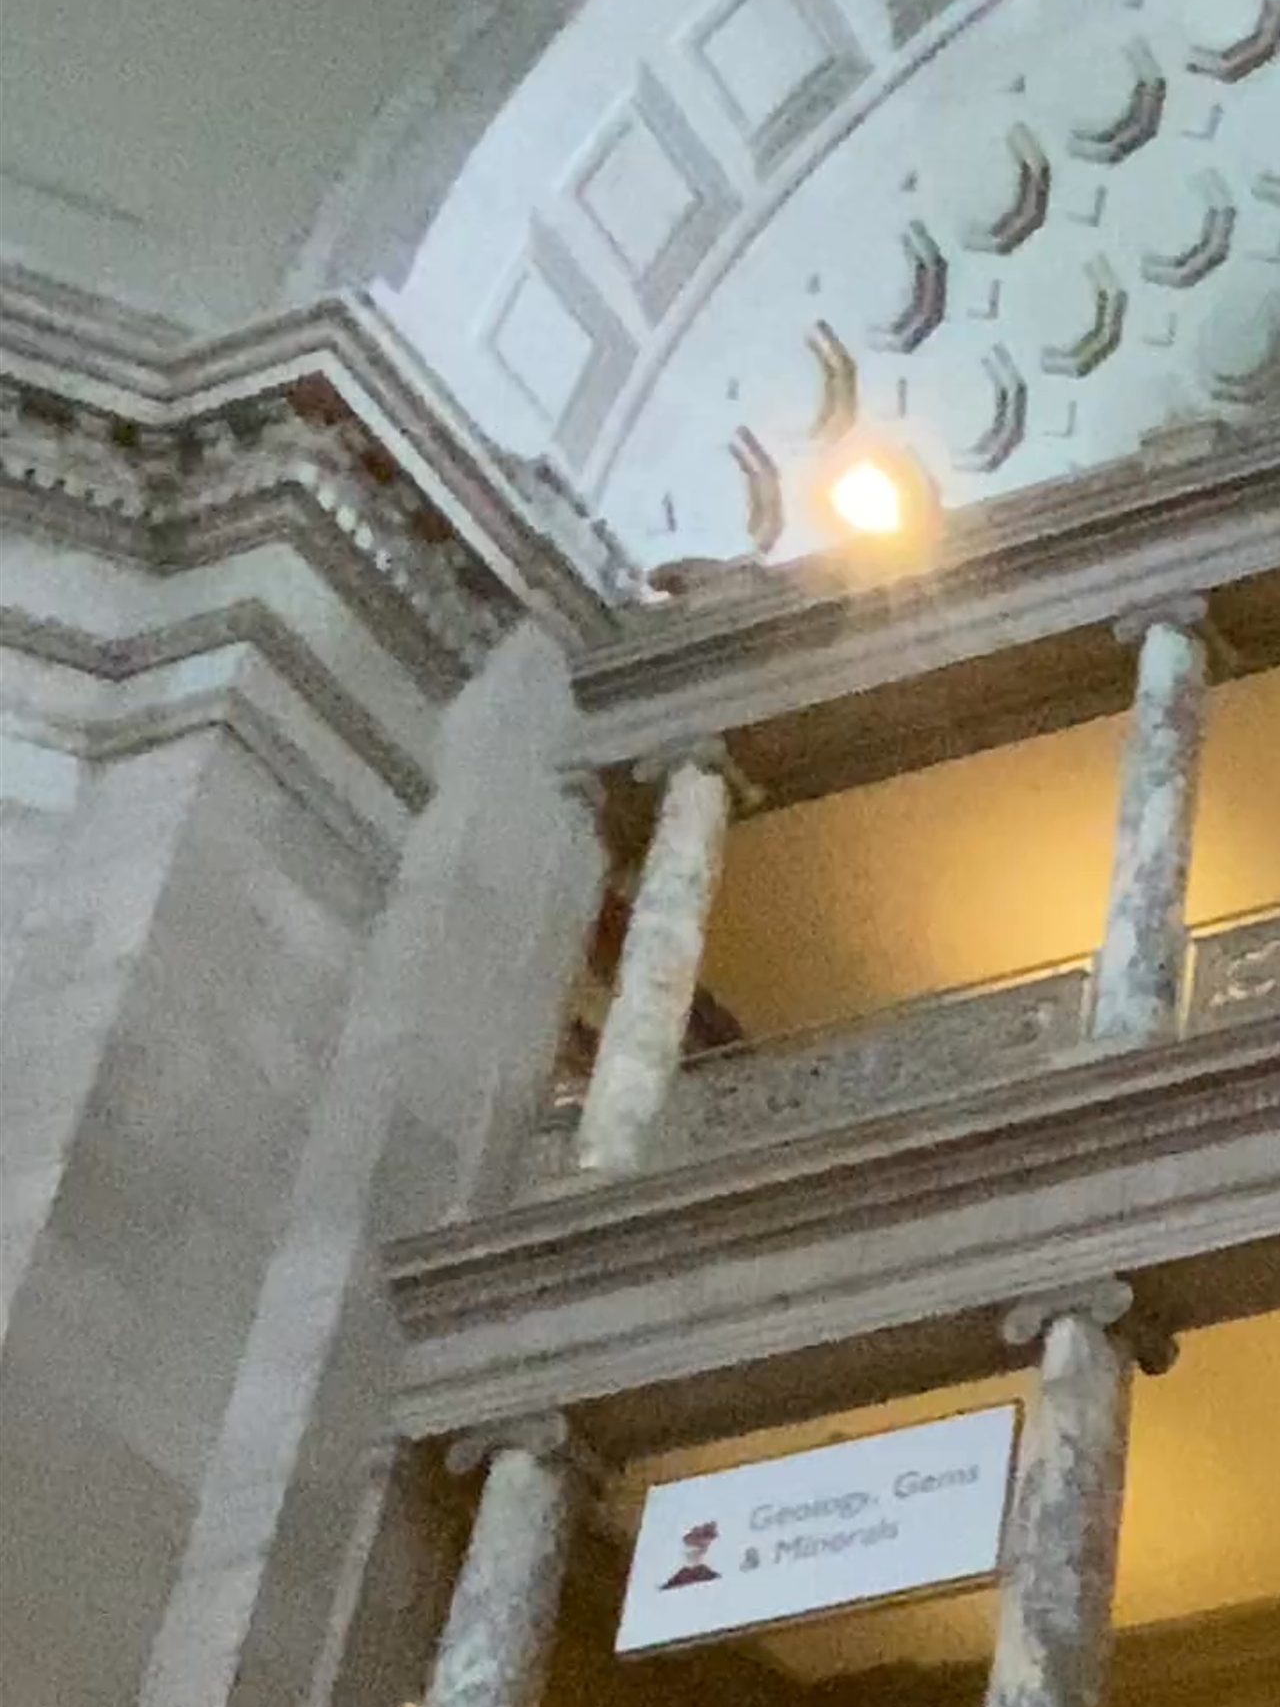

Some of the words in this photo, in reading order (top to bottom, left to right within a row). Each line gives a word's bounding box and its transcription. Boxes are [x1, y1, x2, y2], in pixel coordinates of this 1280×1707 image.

[892, 1464, 980, 1499] Gems
[739, 1547, 761, 1573] &
[773, 1518, 898, 1565] Minerals
